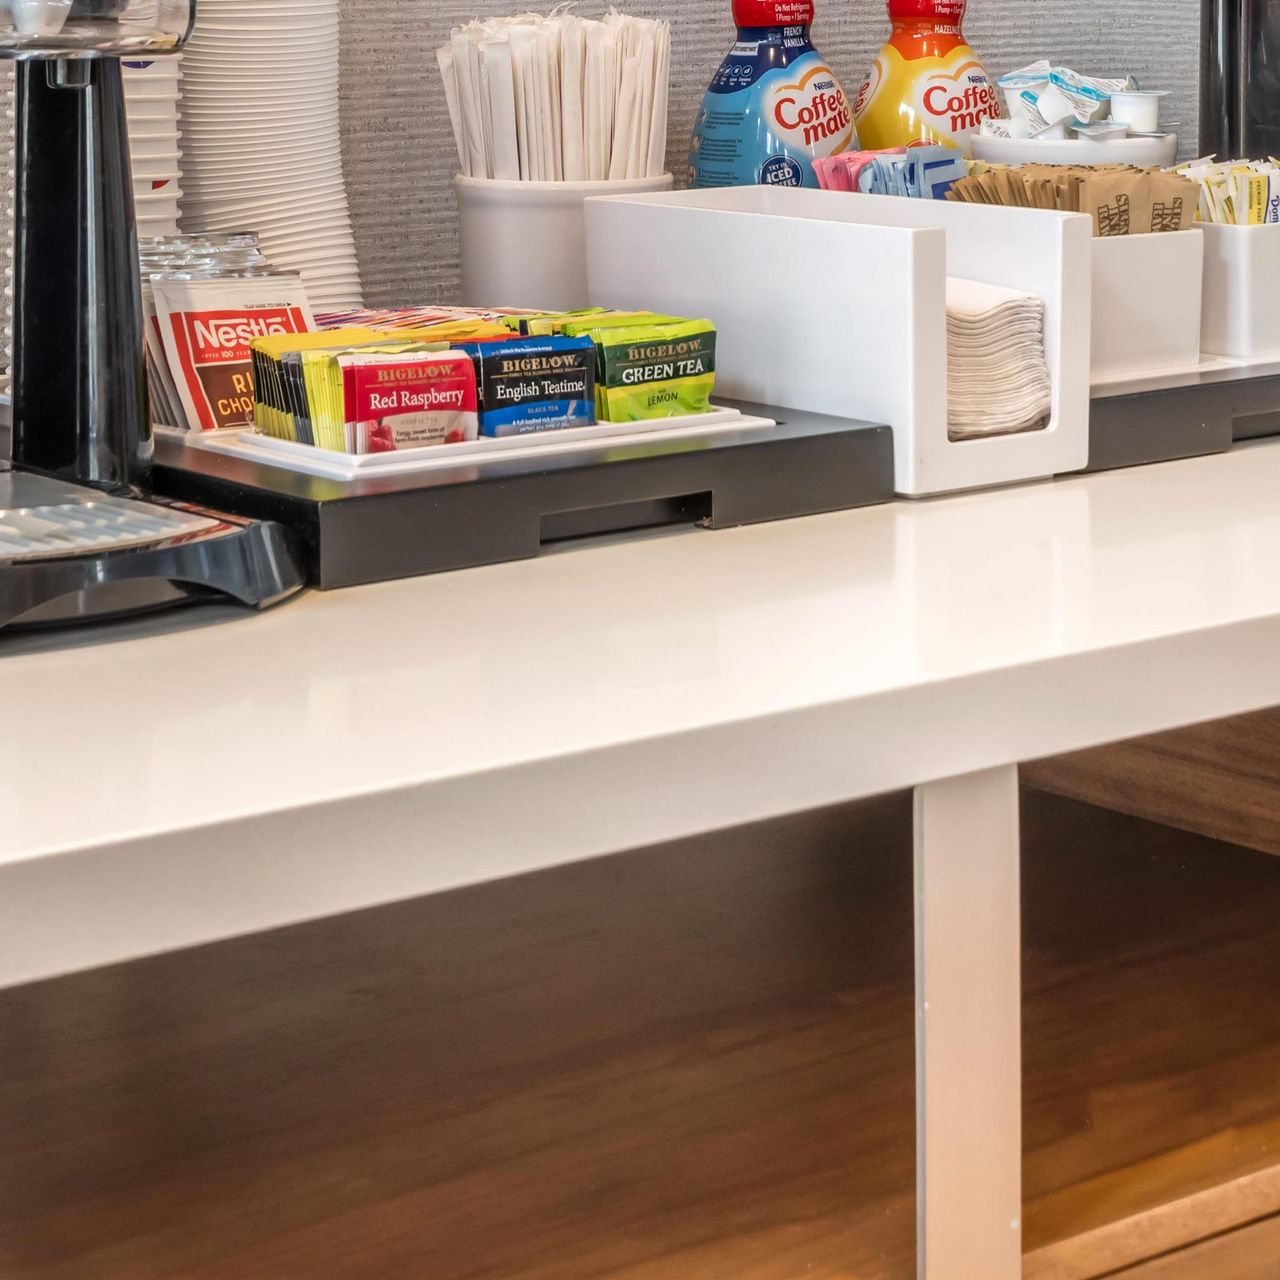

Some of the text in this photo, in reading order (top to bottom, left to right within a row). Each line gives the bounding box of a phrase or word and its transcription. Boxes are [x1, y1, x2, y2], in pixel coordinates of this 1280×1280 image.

[783, 38, 805, 48] VANILLA
[774, 90, 845, 130] Coffee
[922, 85, 995, 116] Coffee
[950, 102, 1001, 132] mate
[803, 110, 851, 146] mate
[767, 167, 793, 183] ICED
[220, 350, 234, 358] 100
[627, 340, 701, 361] BIGELOW
[377, 363, 454, 382] BIGELOW
[502, 354, 576, 373] BIGELOW
[622, 363, 674, 383] GREEN
[676, 358, 705, 375] TEA
[370, 391, 398, 409] Red
[401, 388, 464, 409] Raspberry
[496, 381, 539, 401] English
[647, 392, 678, 407] LEMON
